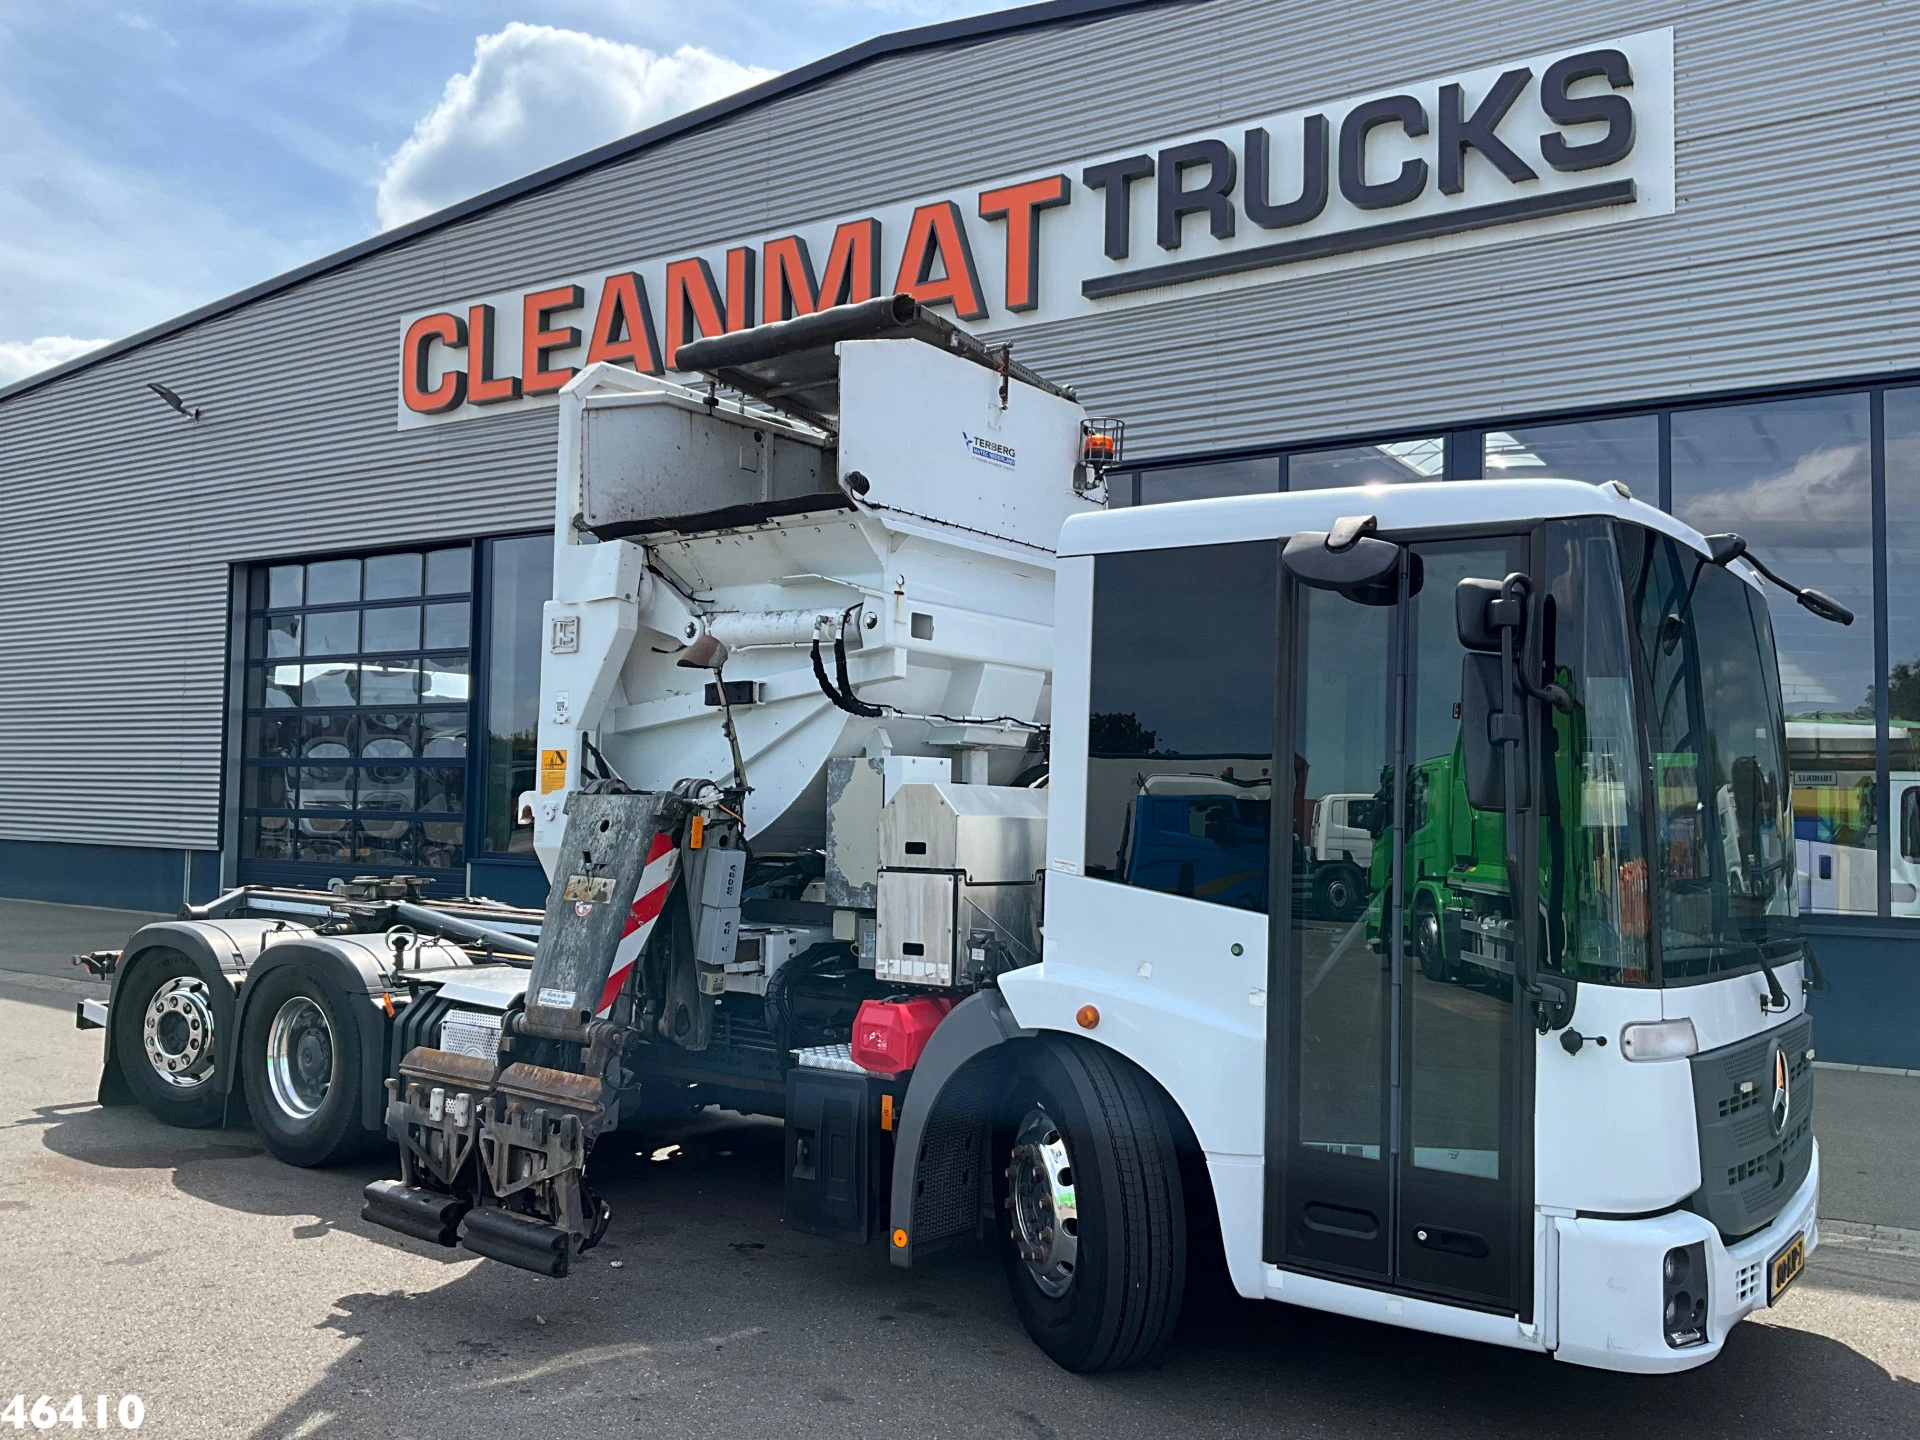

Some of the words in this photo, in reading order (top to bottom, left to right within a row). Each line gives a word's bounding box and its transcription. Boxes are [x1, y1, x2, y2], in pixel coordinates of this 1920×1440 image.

[402, 173, 1072, 415] CLEANMAT
[1082, 48, 1637, 261] TRUCKS
[973, 436, 1016, 458] TERBERG
[726, 864, 736, 896] MOBA
